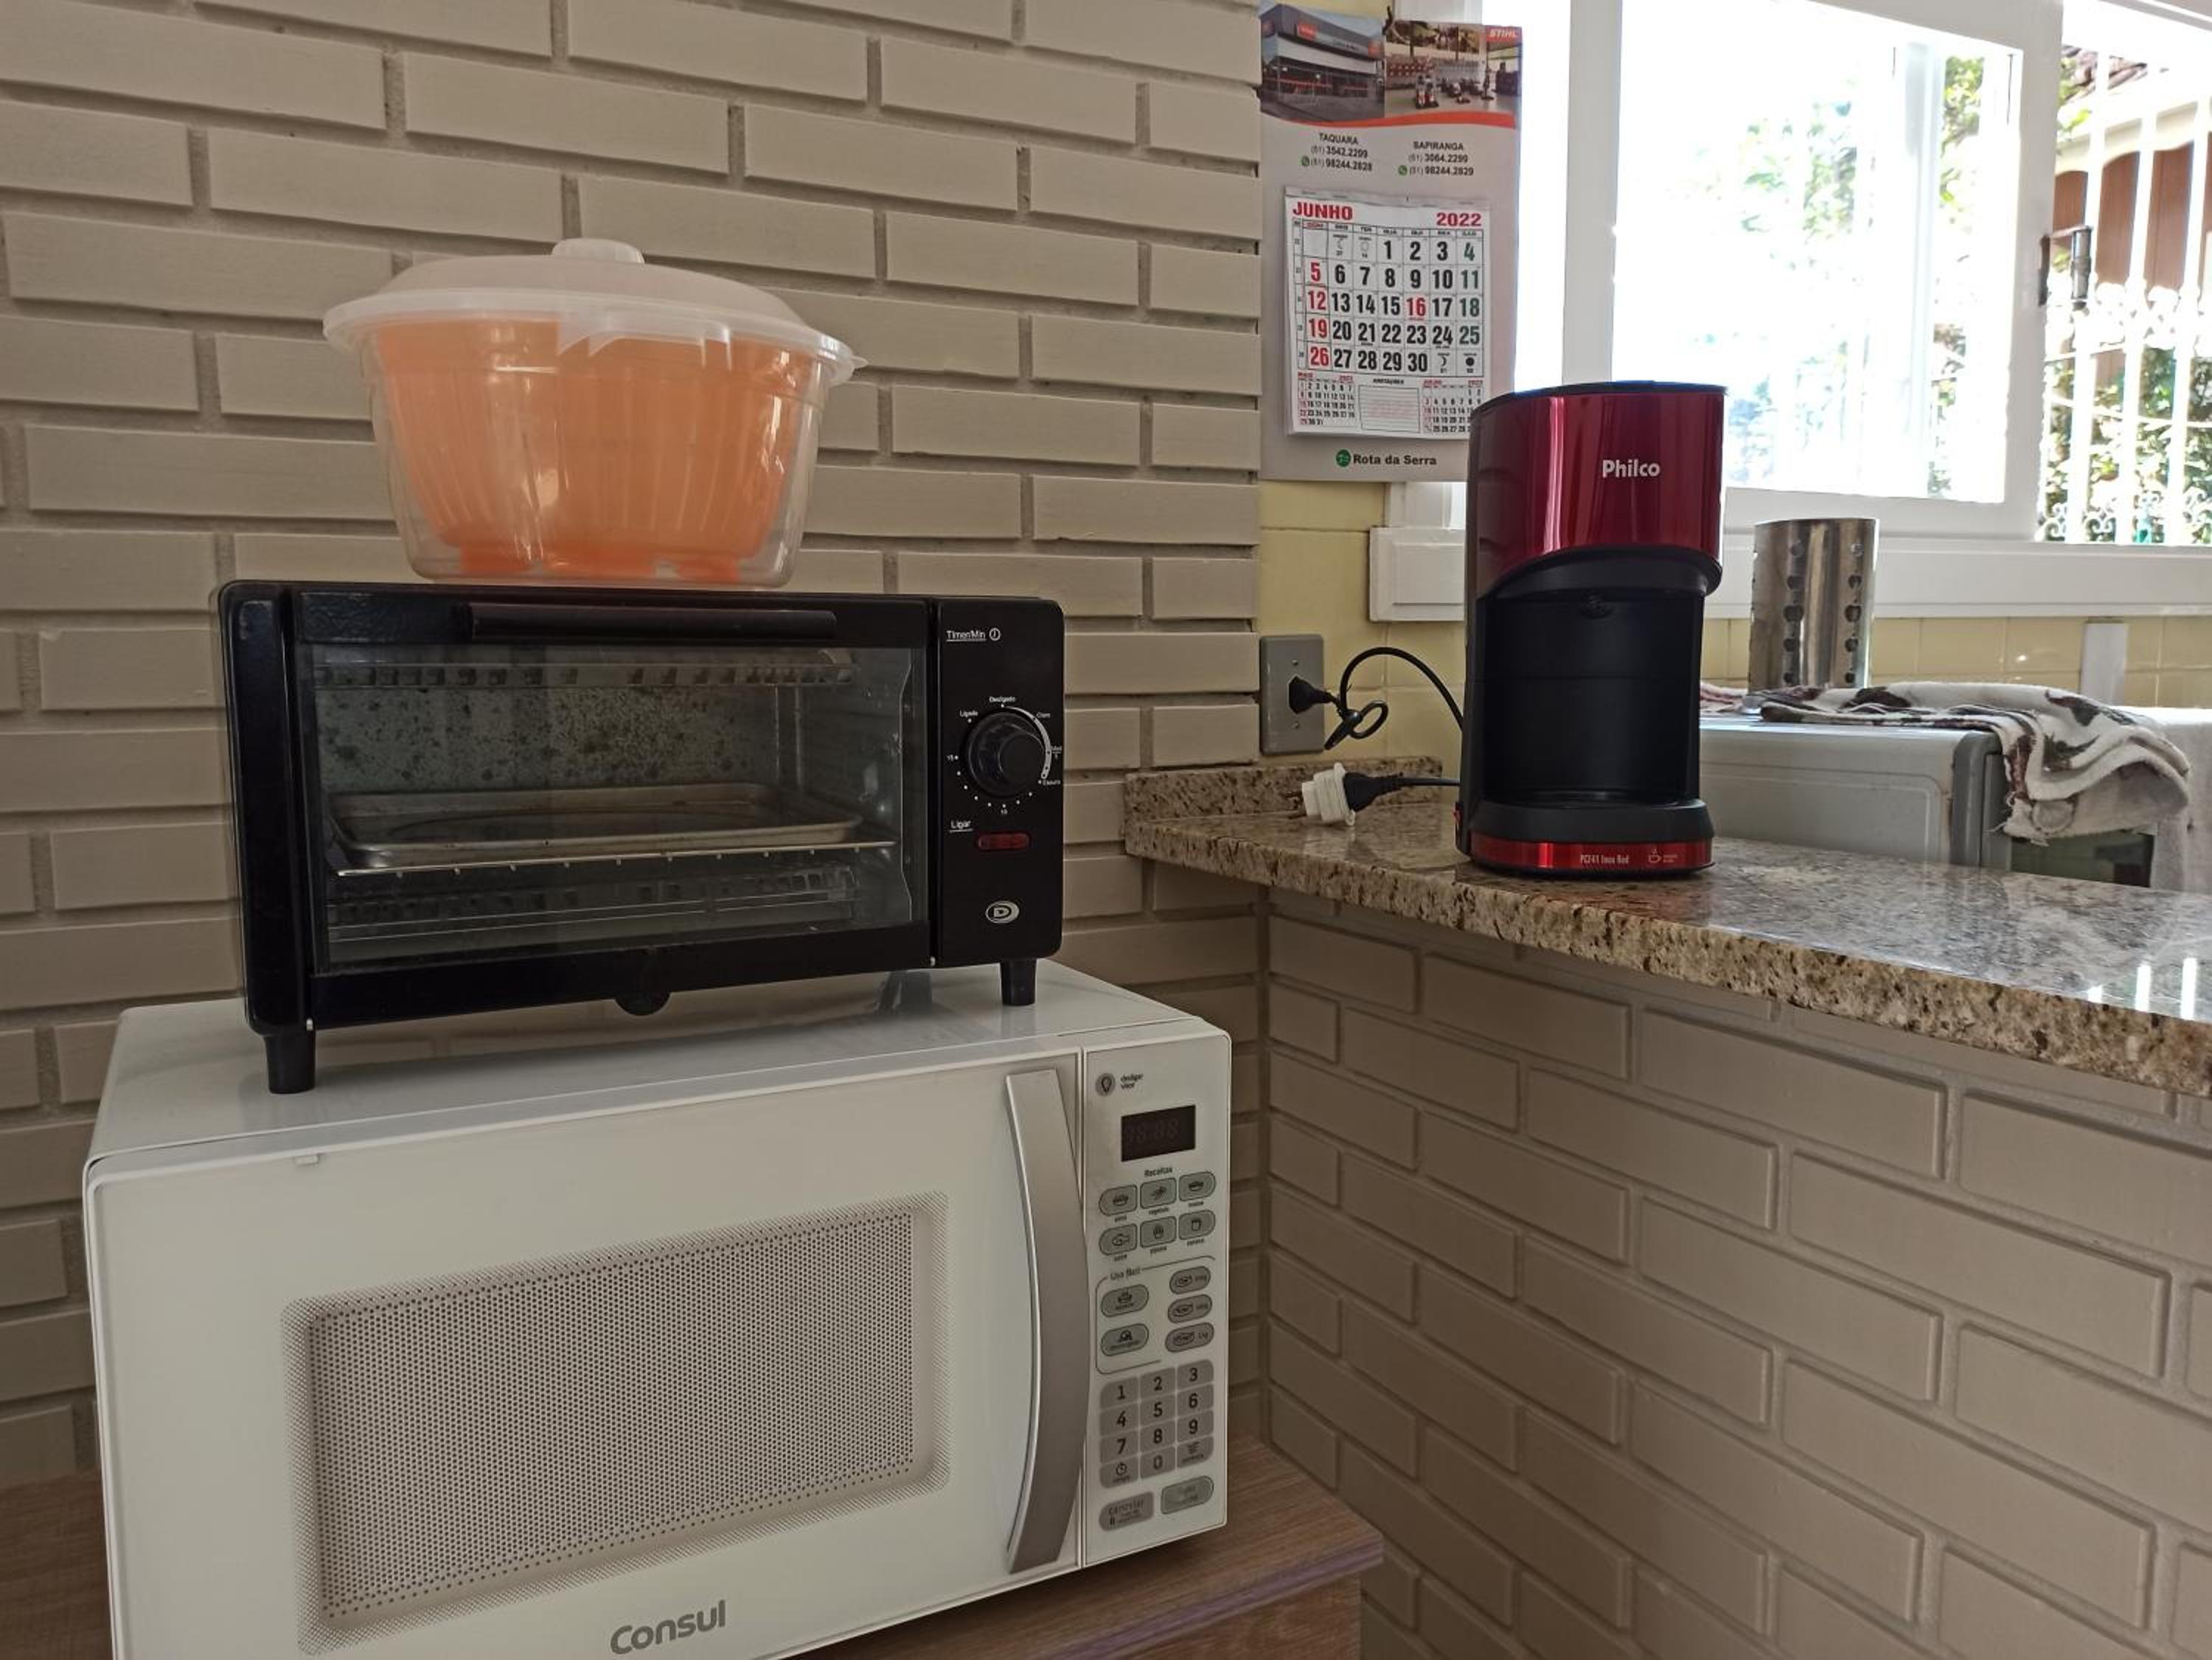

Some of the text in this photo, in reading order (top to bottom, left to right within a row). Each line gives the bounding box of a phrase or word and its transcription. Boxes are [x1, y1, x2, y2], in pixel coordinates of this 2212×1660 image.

[1319, 133, 1359, 145] TAQUARA
[1413, 141, 1464, 151] SAPIRANGA
[1293, 202, 1353, 220] JUNHO
[1436, 212, 1482, 227] 2022
[1383, 240, 1475, 261] 1 2 3 4
[1311, 262, 1478, 289] 5 6 7 8 9 10 11
[1308, 290, 1480, 317] 12 13 14 15 16 17 18
[1309, 318, 1480, 345] 19 20 21 22 23 24 25
[1310, 346, 1427, 372] 26 27 28 29 30
[1353, 454, 1437, 465] Rota da Serra
[1602, 458, 1661, 478] Philco
[1117, 1367, 1198, 1401] 1 2 3
[1117, 1393, 1198, 1427] 4 5 6
[1116, 1420, 1198, 1454] 7 8 9
[1153, 1455, 1163, 1470] 0
[611, 1600, 726, 1655] Consul
